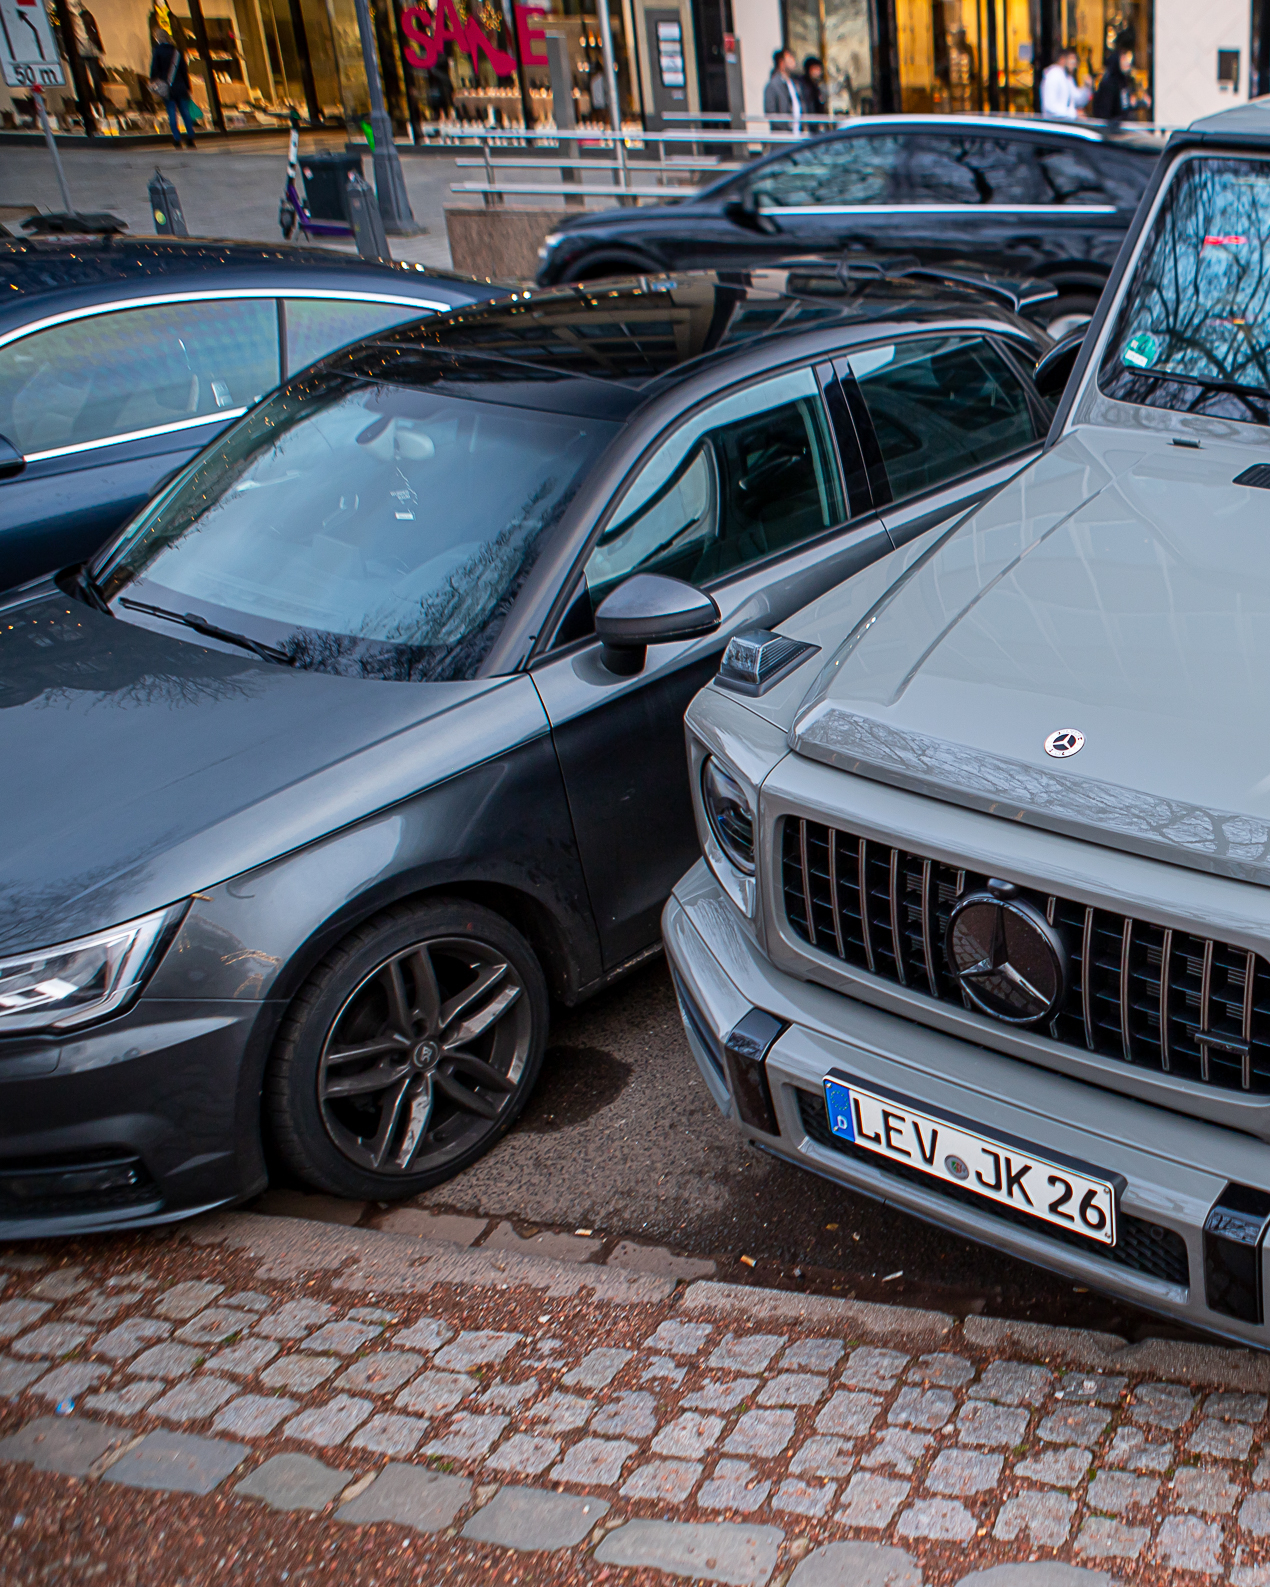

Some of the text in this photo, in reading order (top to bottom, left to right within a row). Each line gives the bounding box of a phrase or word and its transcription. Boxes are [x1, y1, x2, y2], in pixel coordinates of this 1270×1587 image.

[13, 64, 59, 86] 50 m
[837, 1115, 848, 1130] D
[853, 1097, 1107, 1231] LEV JK 26
